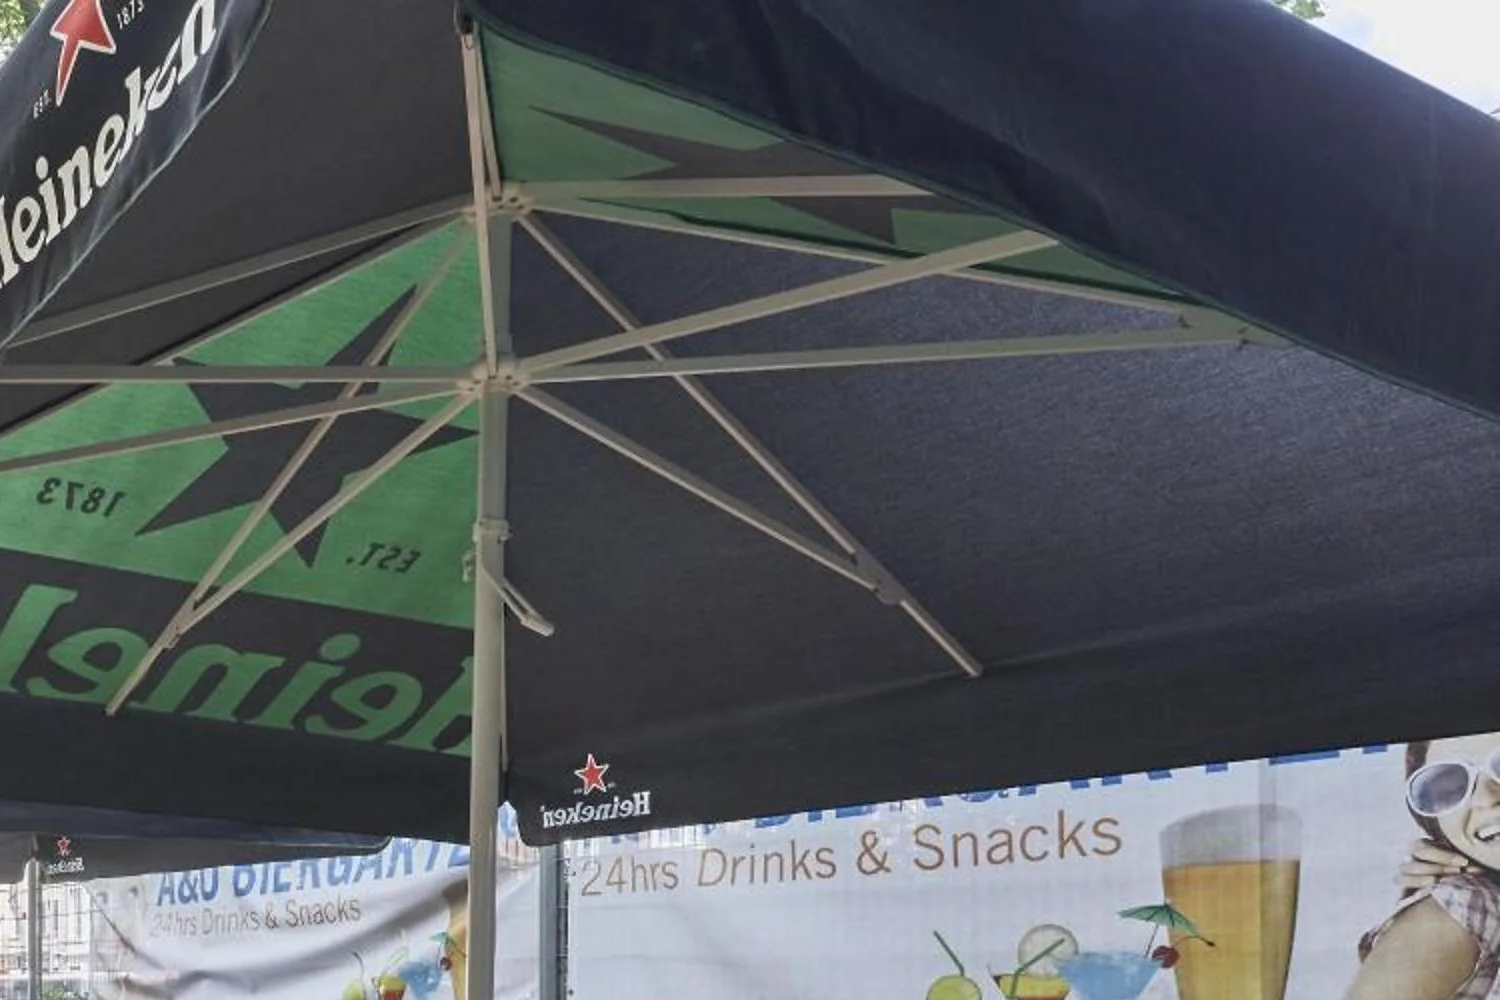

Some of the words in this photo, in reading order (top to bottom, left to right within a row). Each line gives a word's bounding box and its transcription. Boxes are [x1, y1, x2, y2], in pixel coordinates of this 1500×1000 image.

[580, 856, 679, 898] 24hrs
[698, 841, 837, 887] Drinks
[857, 830, 892, 875] &
[913, 810, 1123, 871] Snacks
[201, 906, 260, 936] Drinks
[264, 901, 280, 930] &
[286, 894, 362, 928] Snacks
